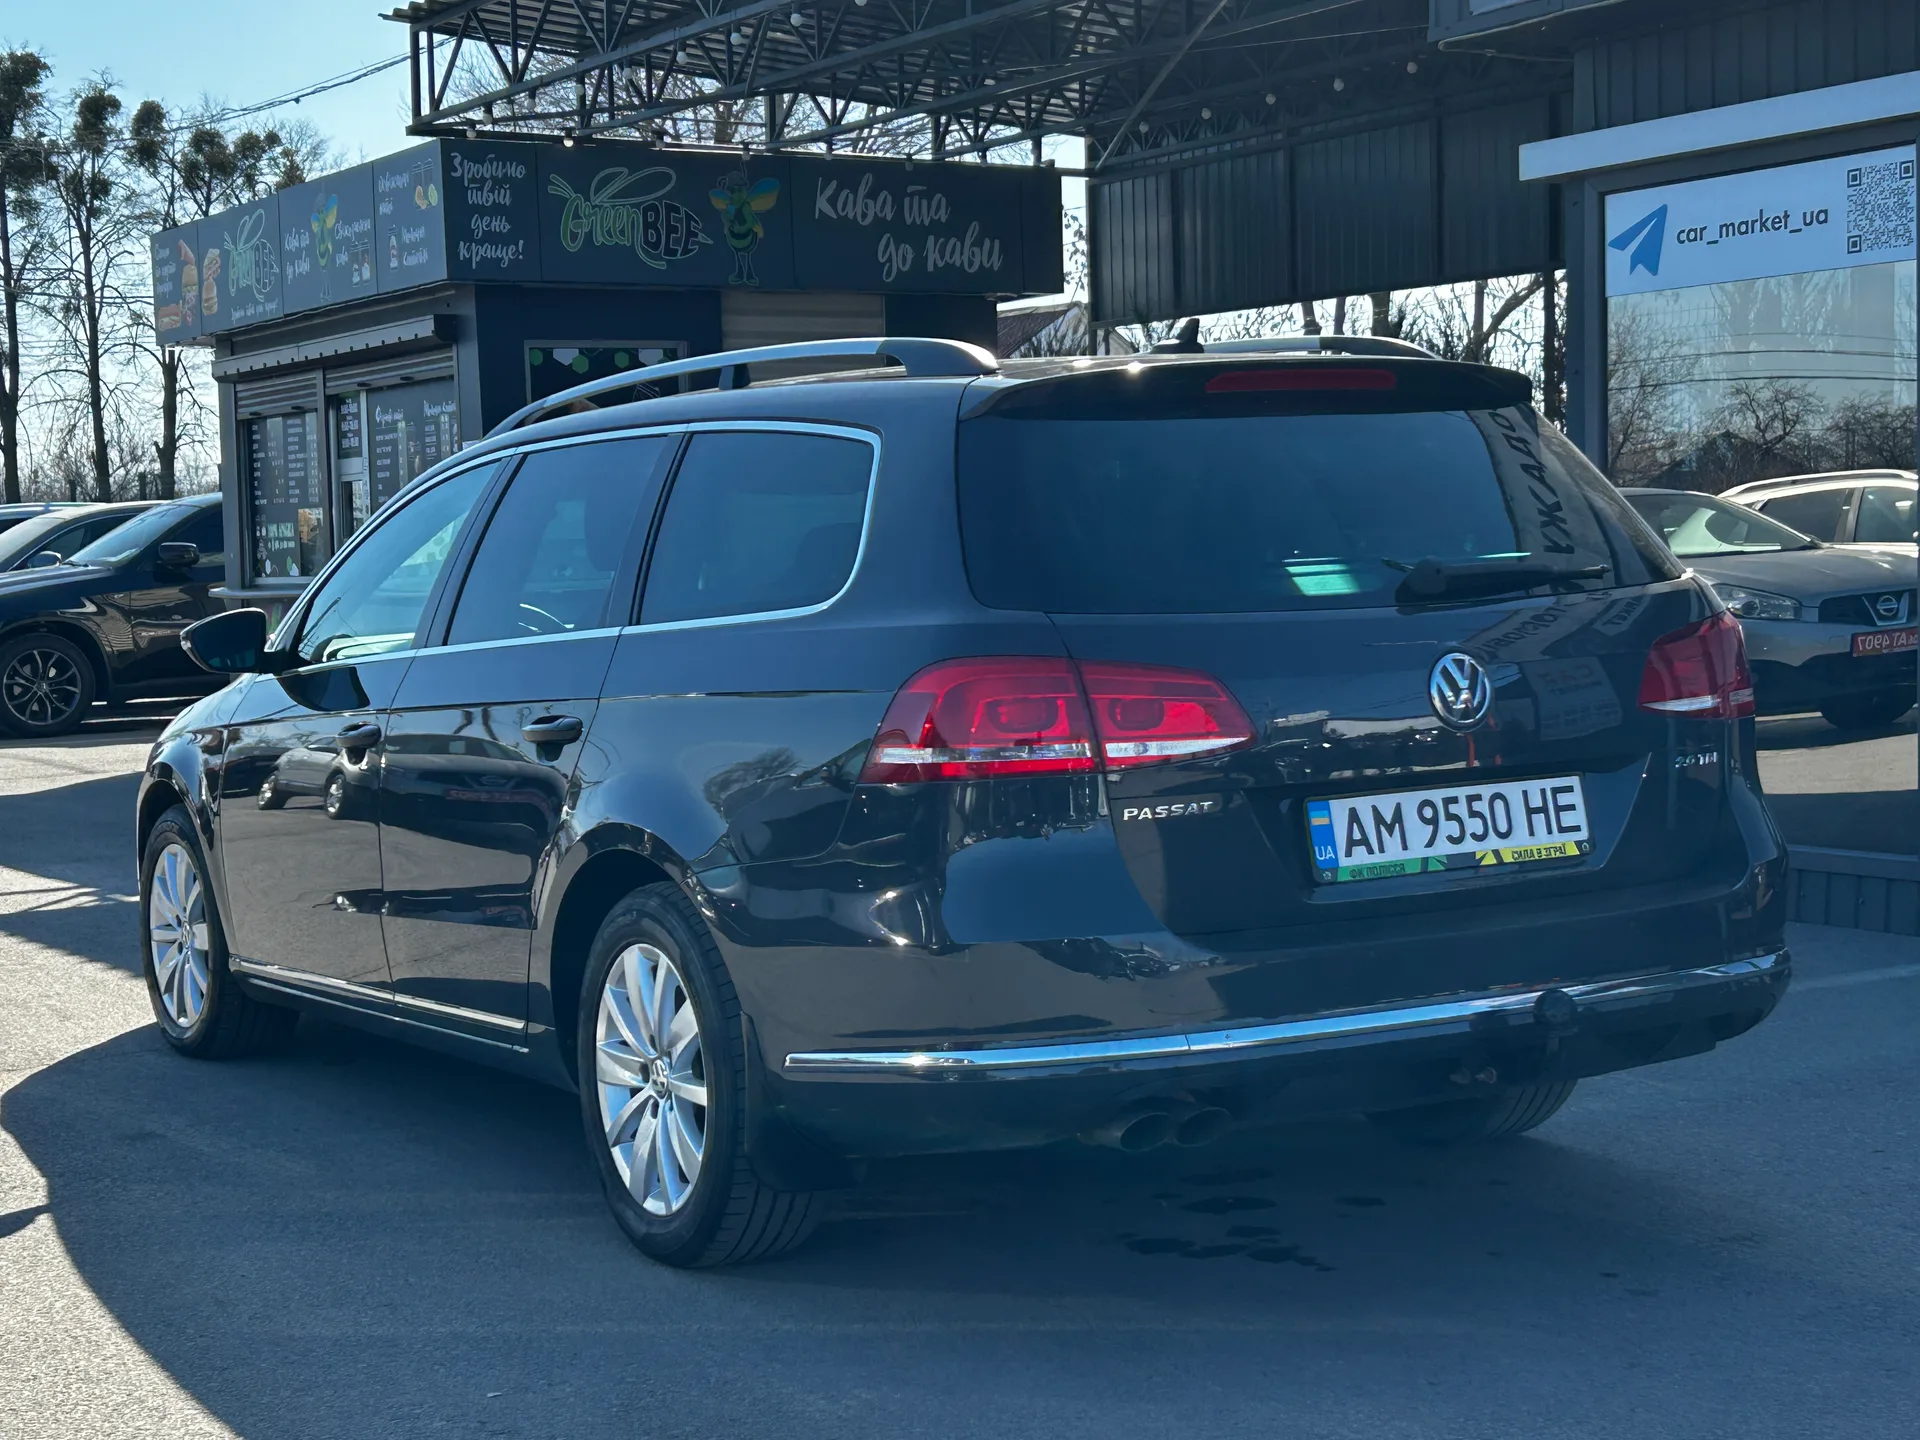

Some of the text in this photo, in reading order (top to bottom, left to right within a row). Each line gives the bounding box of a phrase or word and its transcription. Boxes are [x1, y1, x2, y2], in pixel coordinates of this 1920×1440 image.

[451, 152, 526, 187] Зробимо
[468, 181, 513, 207] твій
[815, 173, 951, 226] Кава та
[471, 213, 511, 240] день
[1676, 207, 1829, 245] car_market_ua
[458, 239, 525, 270] краще!
[877, 221, 1004, 283] до кави
[1122, 801, 1213, 821] PASSAT
[1344, 785, 1582, 858] AM 9550 HE
[1314, 845, 1335, 861] UA
[1512, 849, 1535, 861] СИЛА
